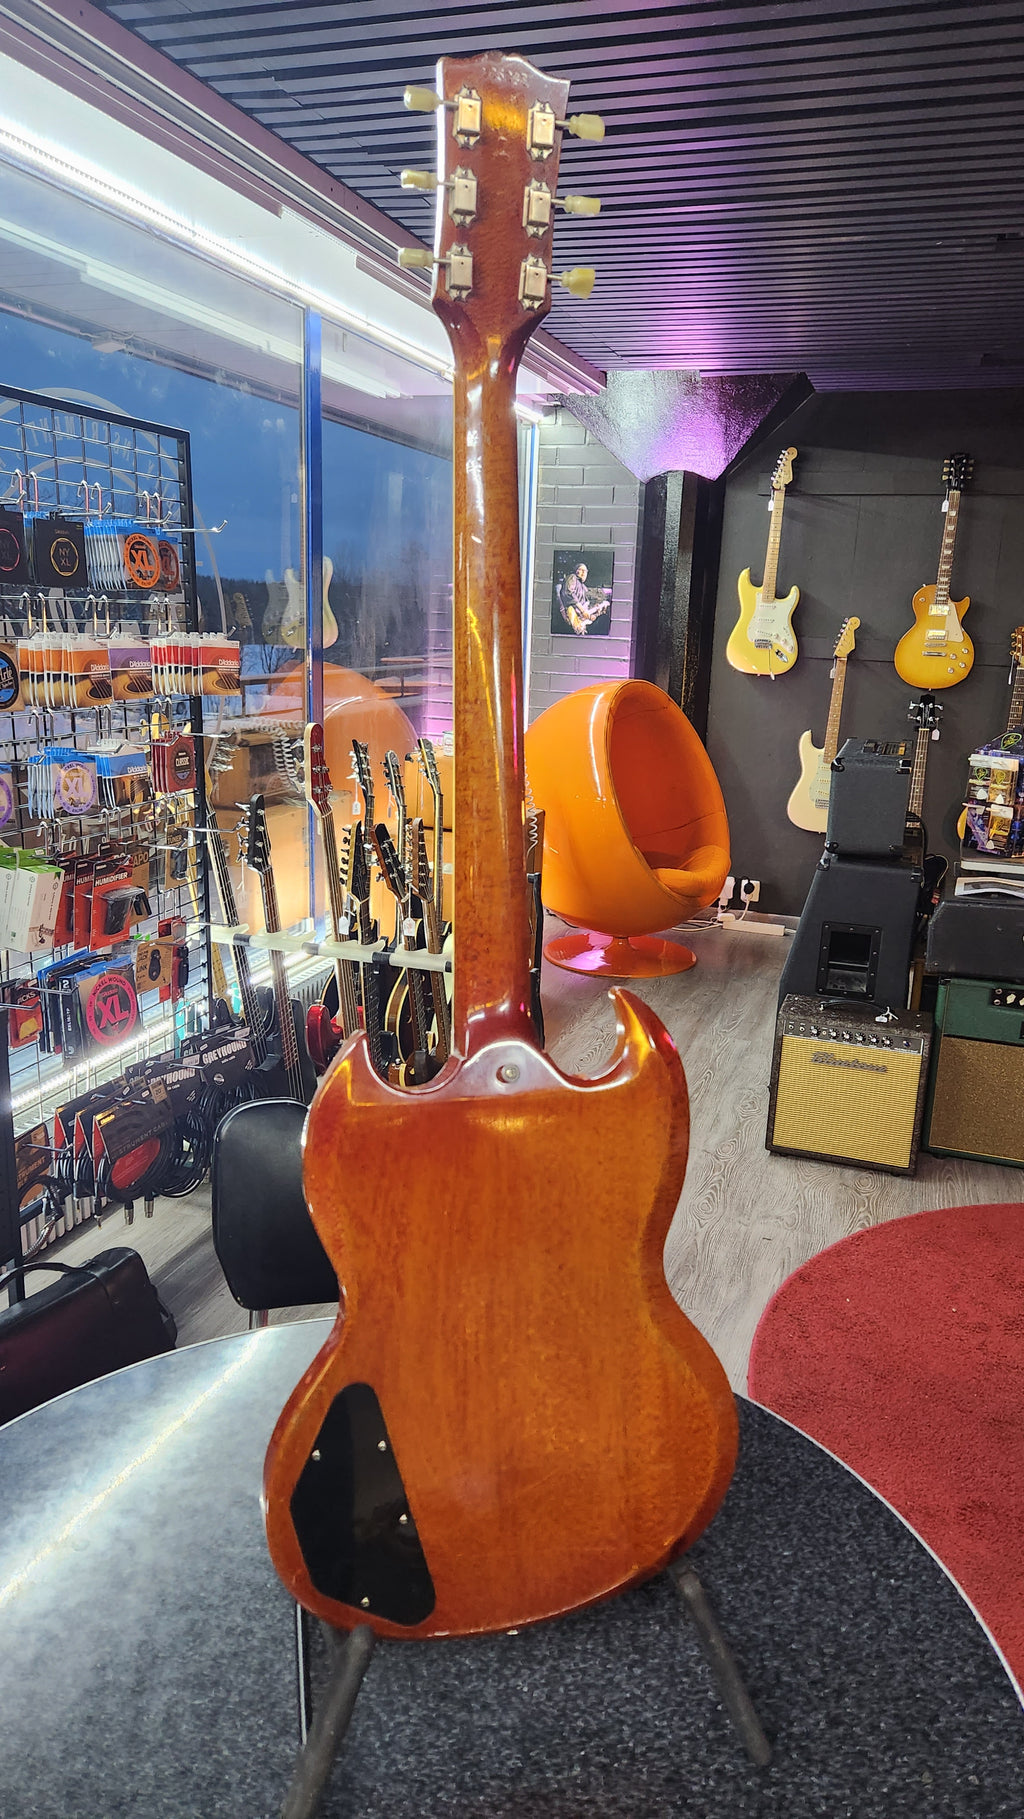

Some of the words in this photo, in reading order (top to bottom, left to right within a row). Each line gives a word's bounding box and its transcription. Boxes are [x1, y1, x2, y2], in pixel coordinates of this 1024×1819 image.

[131, 549, 154, 570] XL
[64, 777, 90, 798] XL
[133, 851, 149, 867] APO
[95, 872, 129, 887] HUMIDIFIER
[97, 994, 130, 1030] XL
[202, 1040, 248, 1065] GREYHOUND
